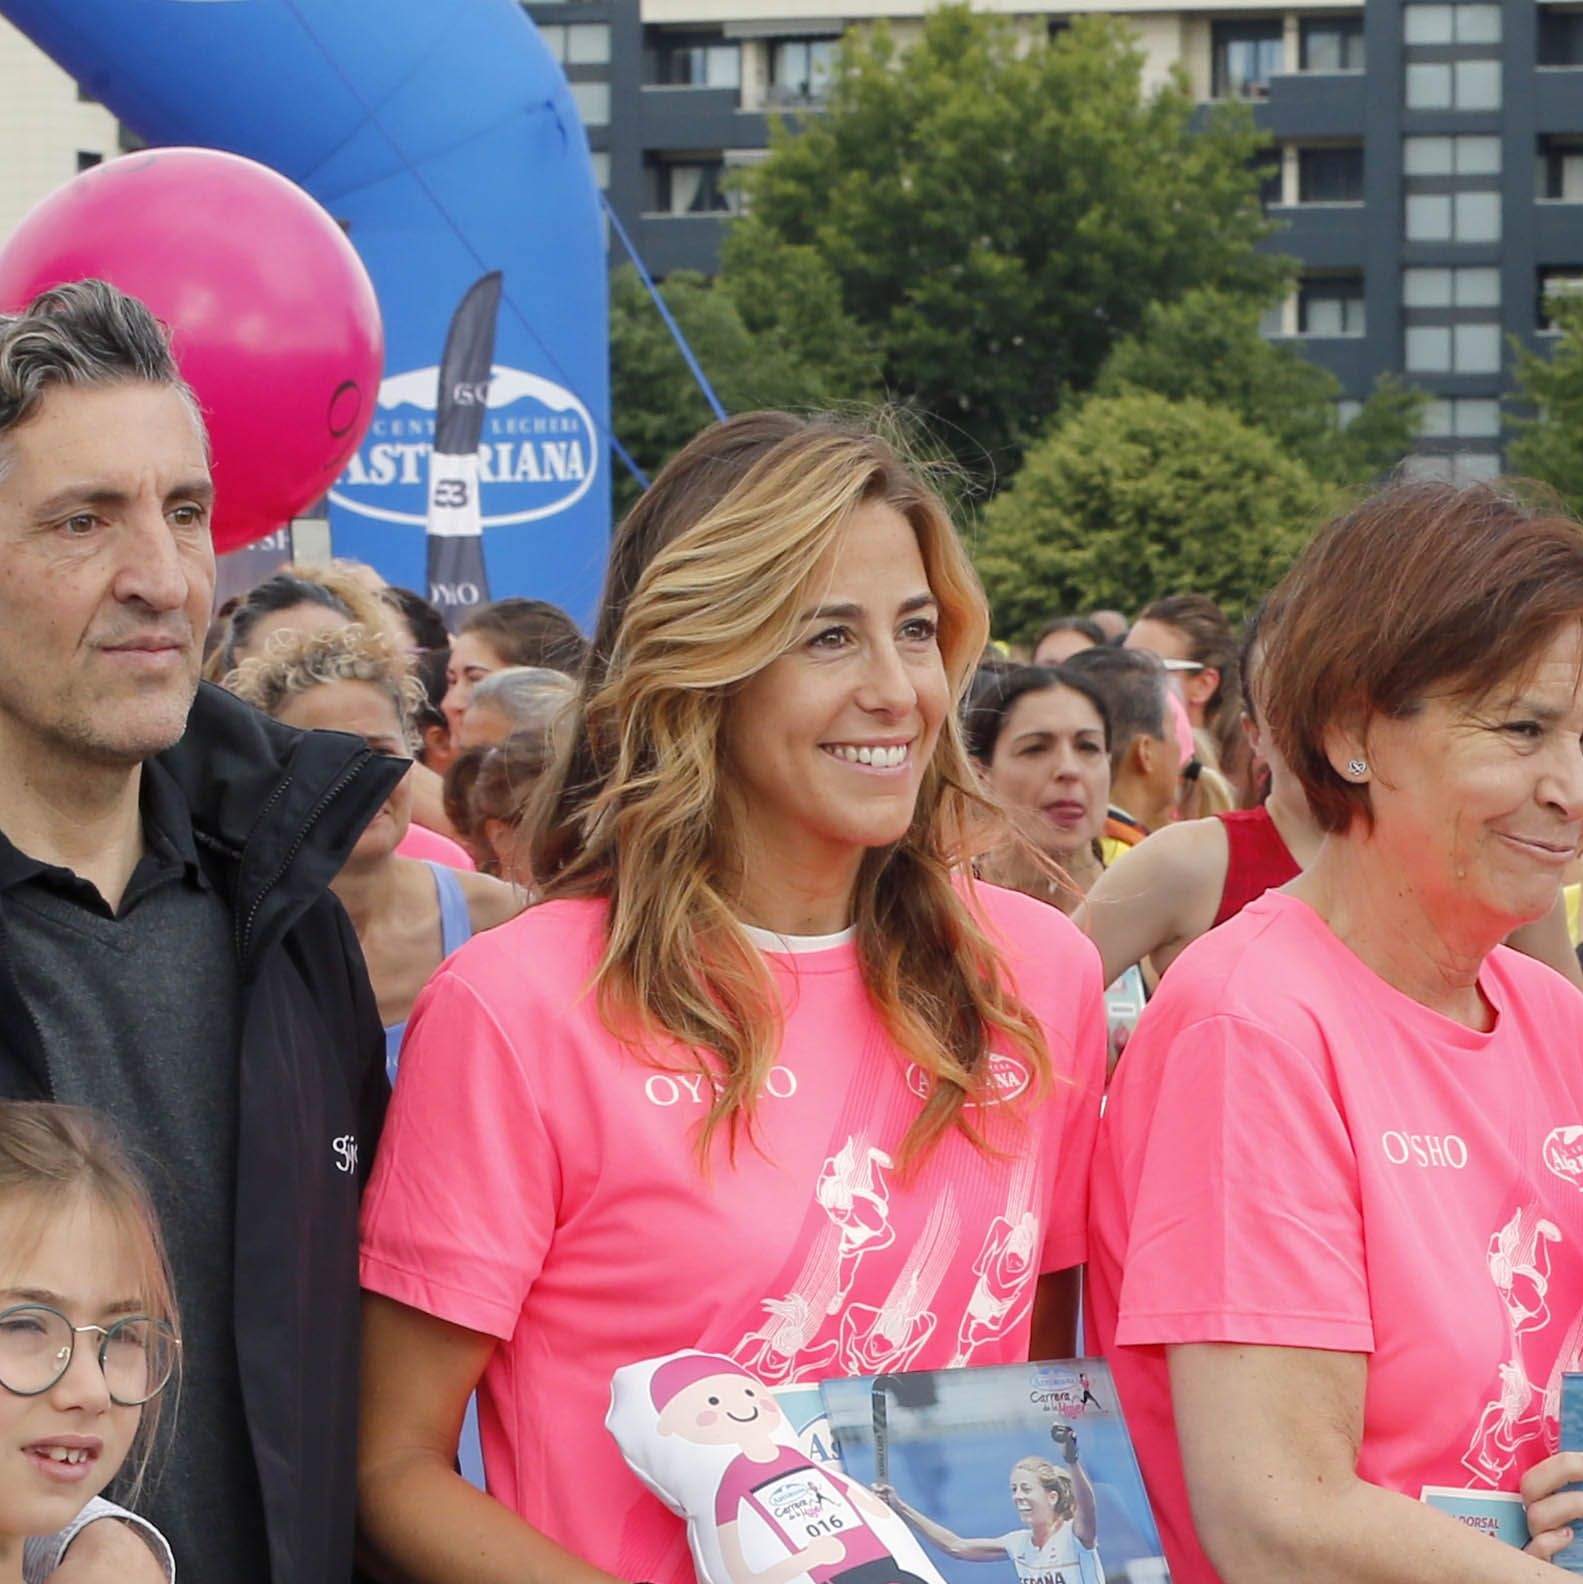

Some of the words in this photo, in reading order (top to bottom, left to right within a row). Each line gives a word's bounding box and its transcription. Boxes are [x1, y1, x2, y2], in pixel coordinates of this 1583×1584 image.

[334, 440, 585, 485] ASTRIANA
[644, 1064, 798, 1107] OYO
[1382, 1131, 1468, 1169] OSHO
[1030, 1391, 1071, 1403] Carrera
[806, 1514, 844, 1538] 016
